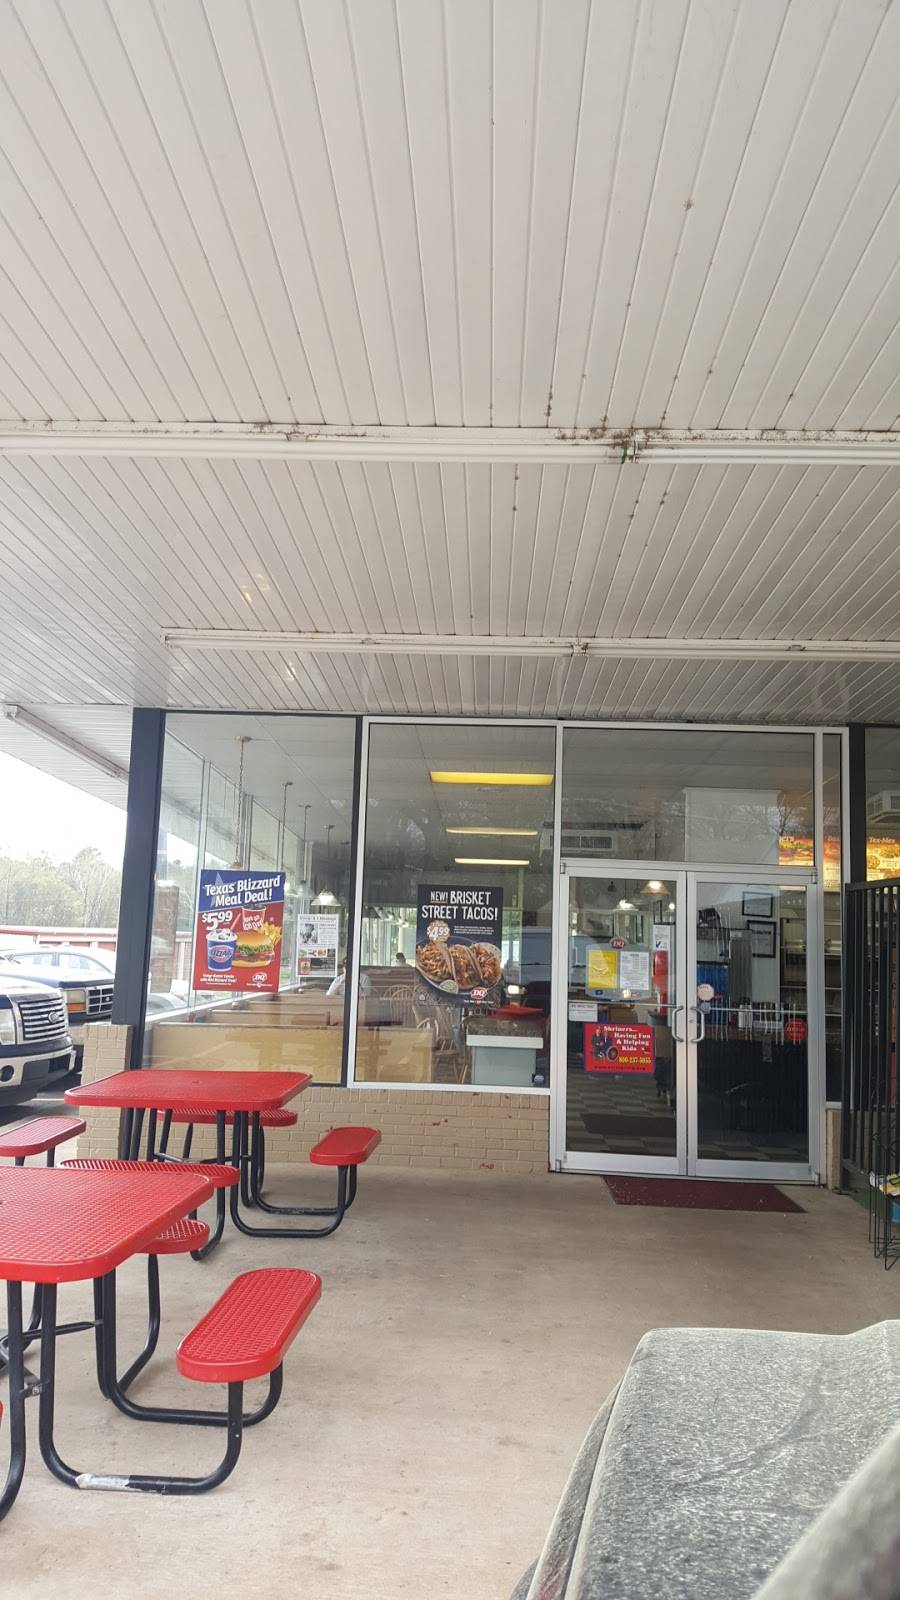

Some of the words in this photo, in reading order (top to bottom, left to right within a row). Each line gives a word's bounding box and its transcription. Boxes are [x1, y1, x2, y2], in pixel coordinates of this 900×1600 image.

[205, 883, 235, 896] Texas
[237, 875, 280, 892] Blizzard
[215, 892, 242, 907] Meal
[244, 888, 273, 903] Deal!
[430, 891, 448, 901] NEW!
[450, 890, 491, 905] BRISKET
[421, 905, 458, 919] STREET
[462, 906, 498, 920] TACOS!
